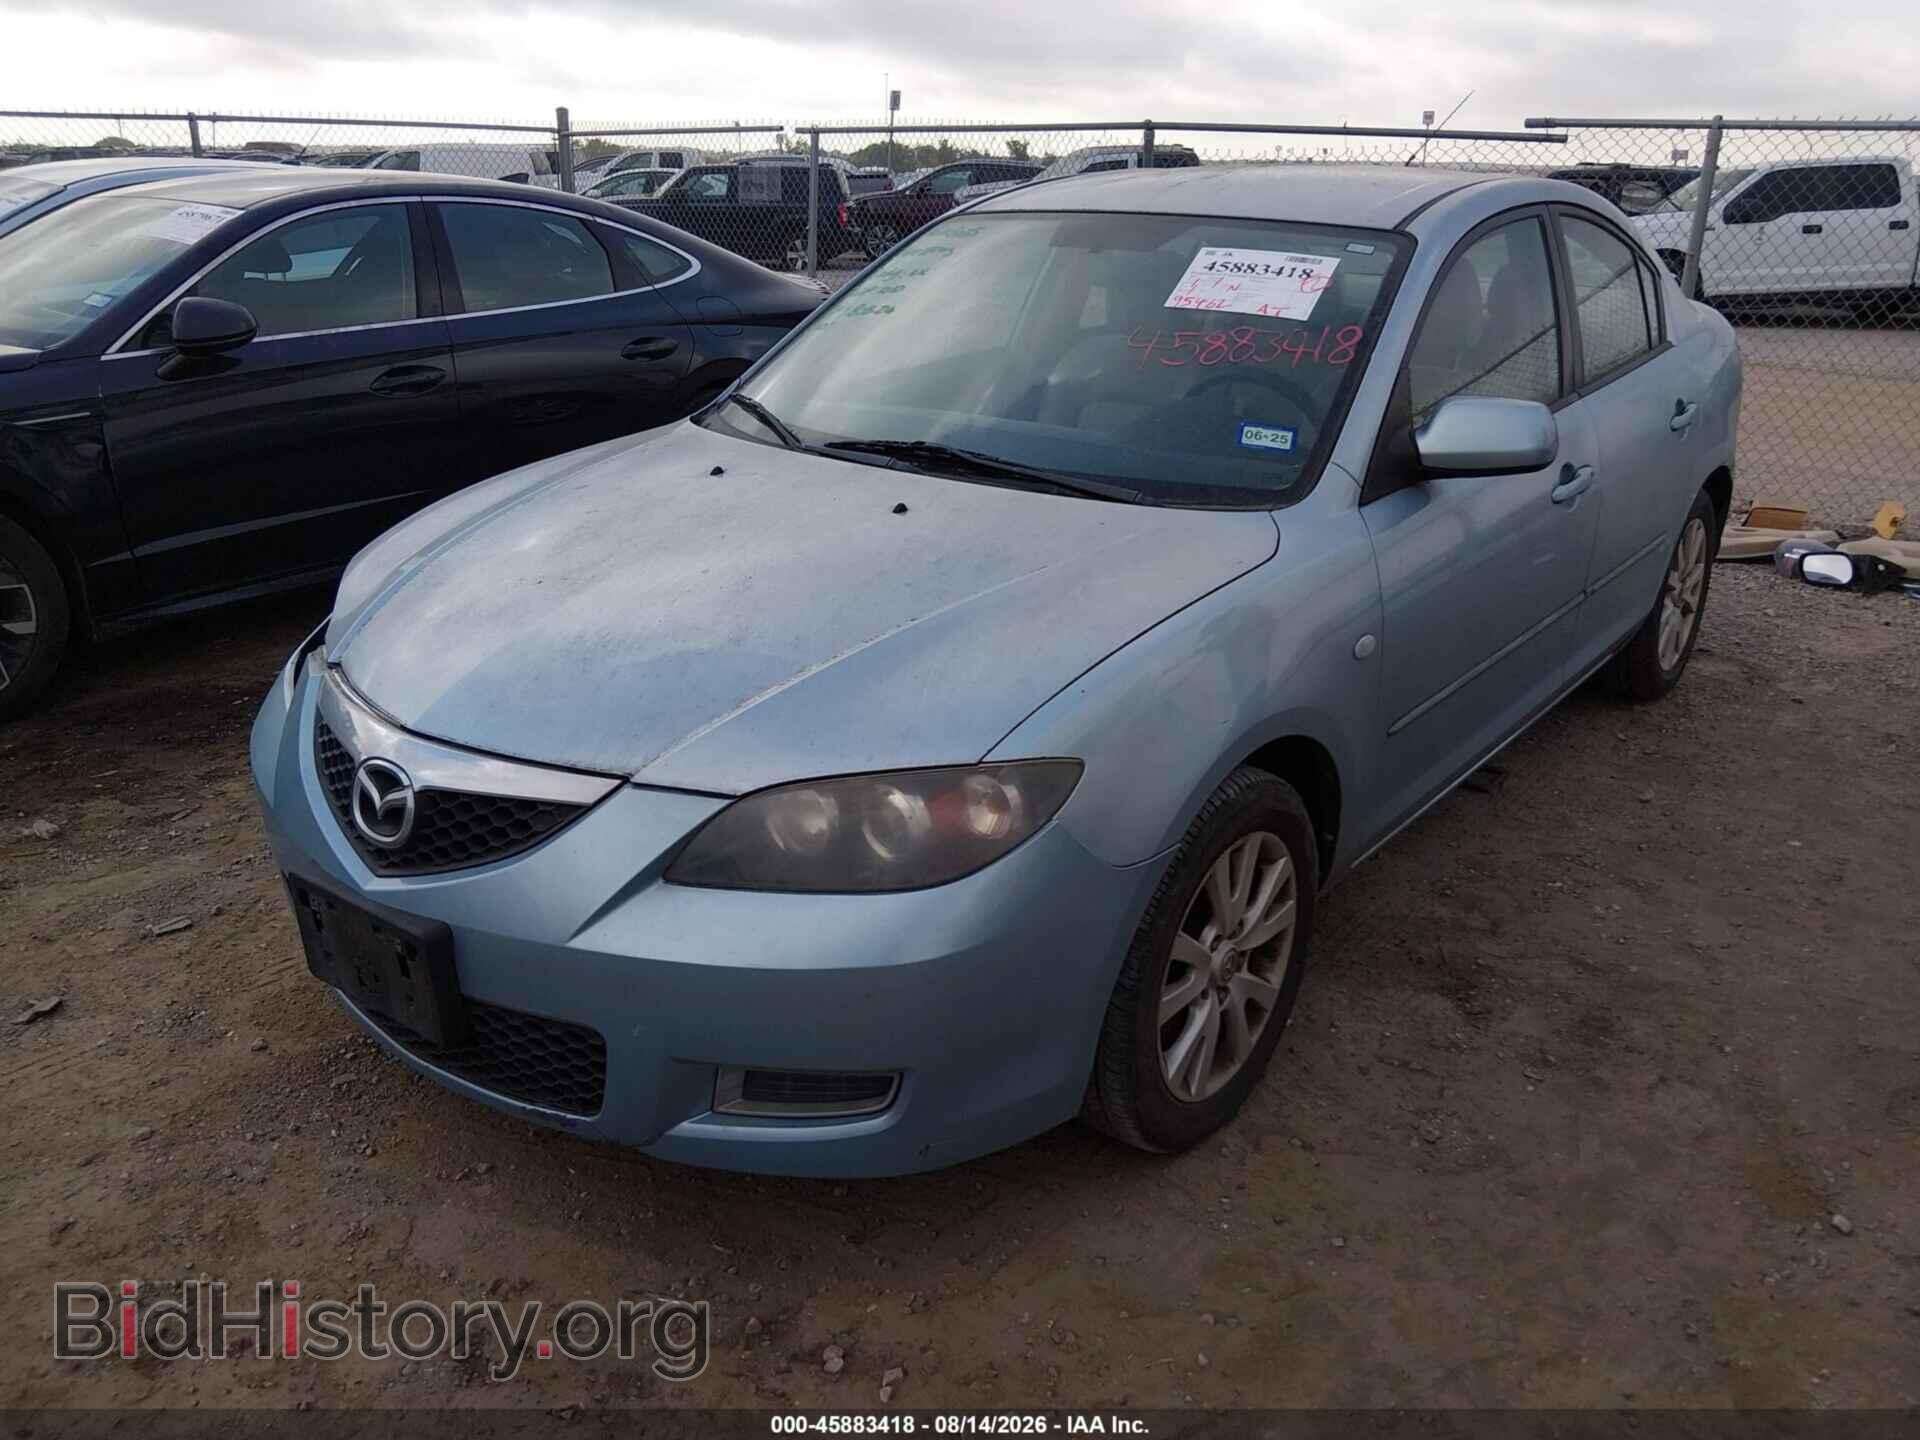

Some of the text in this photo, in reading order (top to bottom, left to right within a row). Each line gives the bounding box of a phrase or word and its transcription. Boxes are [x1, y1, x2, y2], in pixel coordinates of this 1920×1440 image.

[1203, 259, 1314, 279] 45883418
[1127, 325, 1364, 369] 45883418
[1244, 429, 1289, 445] 06-25
